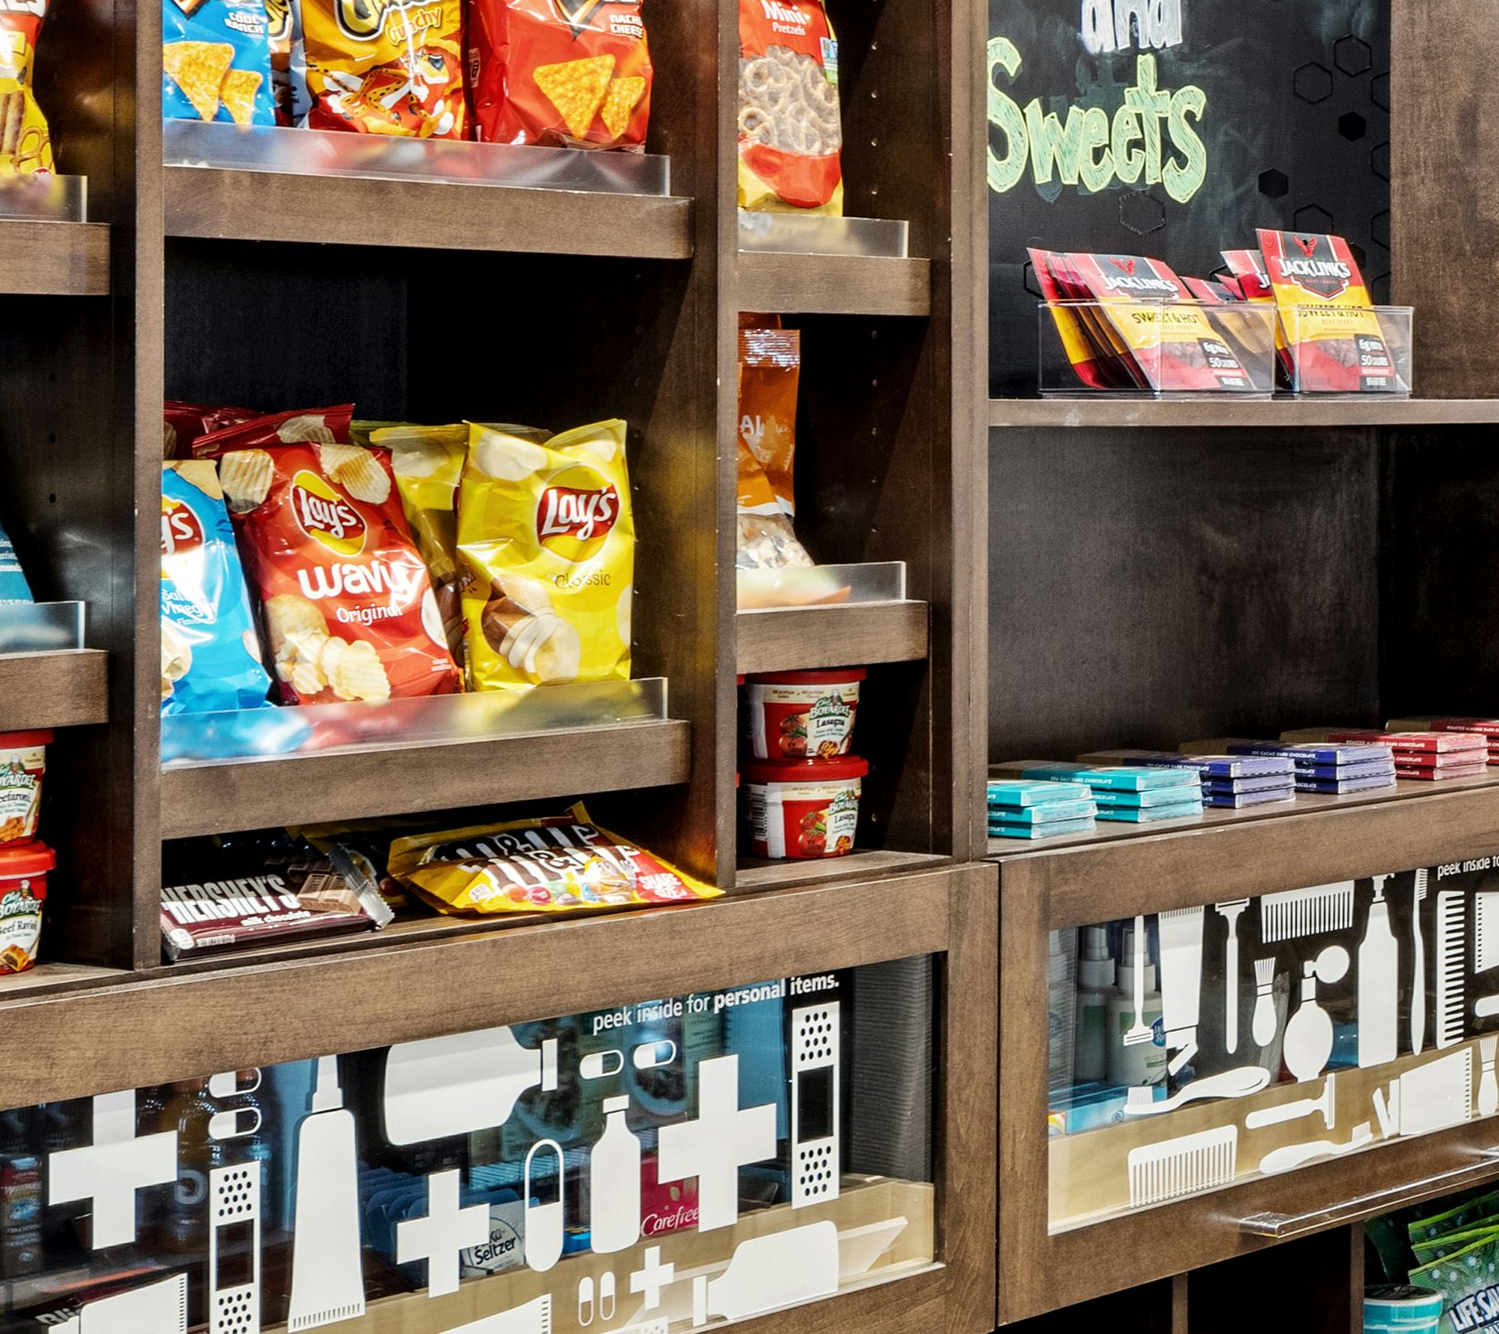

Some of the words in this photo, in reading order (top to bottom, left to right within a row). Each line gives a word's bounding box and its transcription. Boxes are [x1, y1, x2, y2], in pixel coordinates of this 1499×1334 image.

[224, 18, 264, 35] RANCH
[385, 7, 443, 46] Crunchy
[772, 21, 806, 36] Pretzels
[987, 36, 1208, 204] Sweets
[298, 487, 358, 539] Lay's
[541, 486, 616, 541] Lay's
[297, 560, 425, 609] wavy
[554, 569, 612, 589] Classic
[336, 602, 403, 625] Original
[638, 872, 682, 891] SHARE
[1437, 861, 1461, 881] peek
[264, 910, 312, 924] chocolate
[592, 1010, 632, 1035] peek
[637, 999, 683, 1024] inside
[686, 993, 711, 1013] for
[713, 978, 786, 1015] personal
[789, 972, 840, 996] items.
[641, 1204, 700, 1237] Carefree
[474, 1234, 517, 1265] Seltzer
